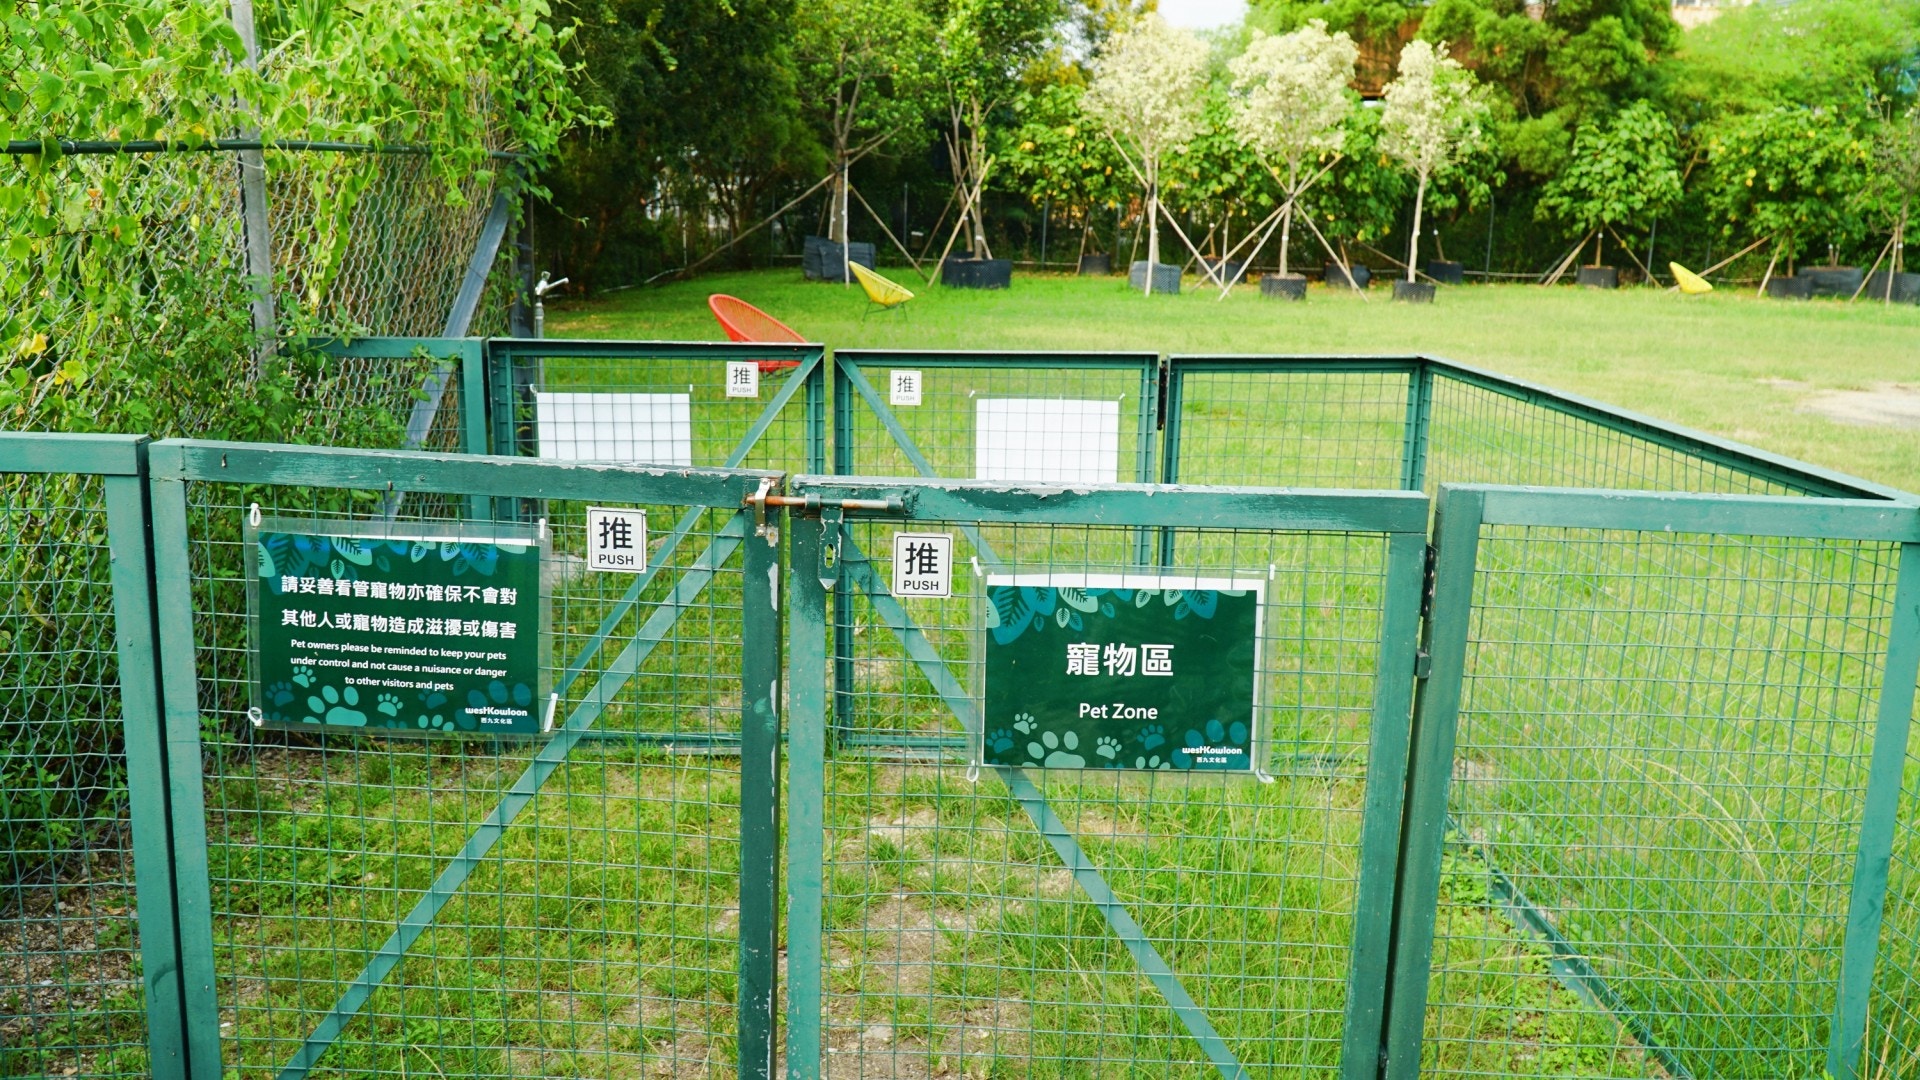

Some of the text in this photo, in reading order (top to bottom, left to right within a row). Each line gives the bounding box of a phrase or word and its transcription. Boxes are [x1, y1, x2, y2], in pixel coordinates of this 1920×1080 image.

[734, 367, 750, 384] 推
[732, 386, 752, 395] PUSH
[898, 376, 913, 392] 推
[896, 394, 915, 403] PUSH
[599, 517, 633, 549] 推
[598, 554, 634, 566] PUSH
[905, 542, 938, 575] 推
[282, 575, 517, 605] 請妥善看管寵物亦確保不會對
[904, 580, 938, 591] PUSH
[282, 609, 516, 639] 其他人或寵物造成滋擾或傷害
[291, 638, 506, 661] Pet owners please be reminded to keep your pets
[291, 656, 317, 666] under
[319, 658, 350, 668] control
[352, 660, 368, 669] and
[371, 662, 385, 670] not
[388, 663, 412, 672] cause
[422, 664, 461, 675] nuisance
[463, 667, 473, 675] or
[475, 667, 506, 678] danger
[1066, 642, 1174, 676] 寵物區
[345, 676, 453, 692] to other visitors and pets
[1080, 703, 1157, 719] Pet Zone
[481, 716, 513, 726] 西九文化區
[1196, 756, 1227, 764] 西九文化區
